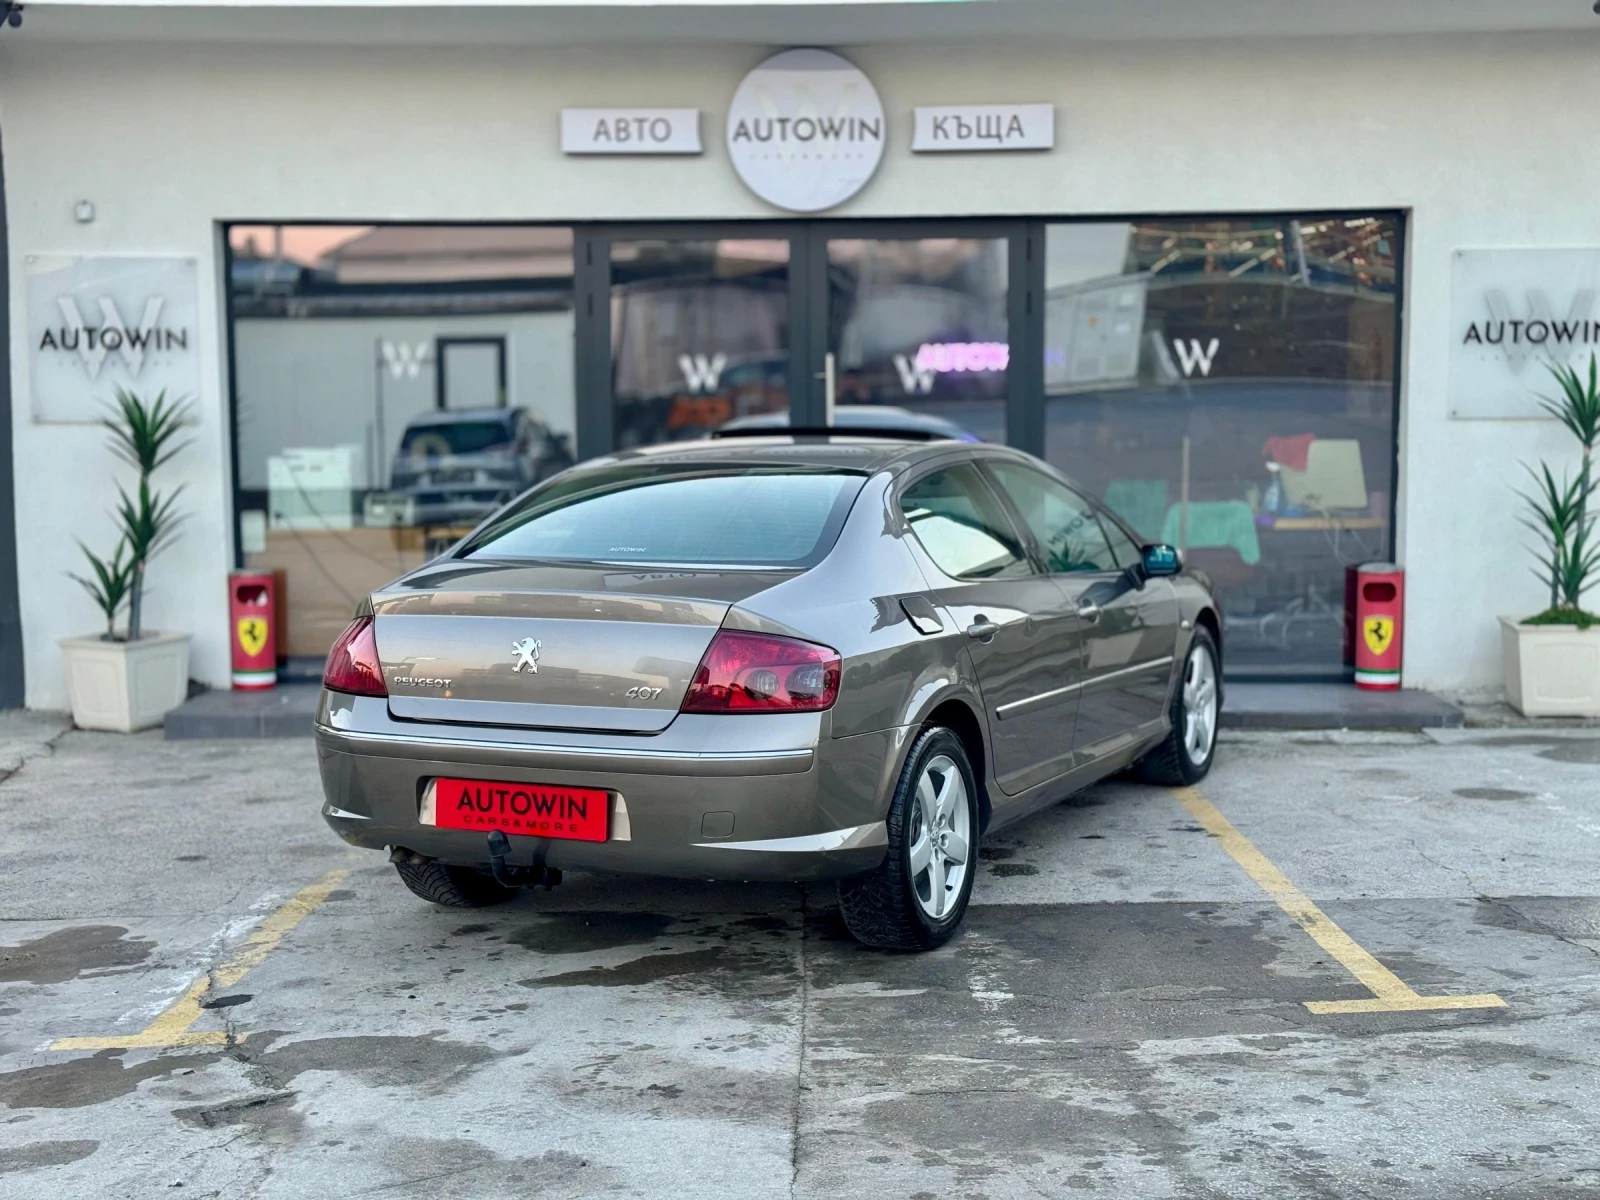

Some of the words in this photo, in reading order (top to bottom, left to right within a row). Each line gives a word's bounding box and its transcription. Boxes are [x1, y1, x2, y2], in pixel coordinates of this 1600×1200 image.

[592, 117, 672, 142] АВТО
[732, 117, 881, 142] AUTOWIN
[932, 113, 1025, 143] КЪЩА
[39, 326, 187, 350] AUTOWIN
[381, 341, 427, 379] W
[1174, 338, 1219, 377] W
[678, 353, 728, 392] W
[393, 676, 452, 690] PEUGEOT
[625, 686, 662, 701] 407
[456, 786, 588, 821] AUTOWIN
[463, 814, 578, 832] CARS&MORE
